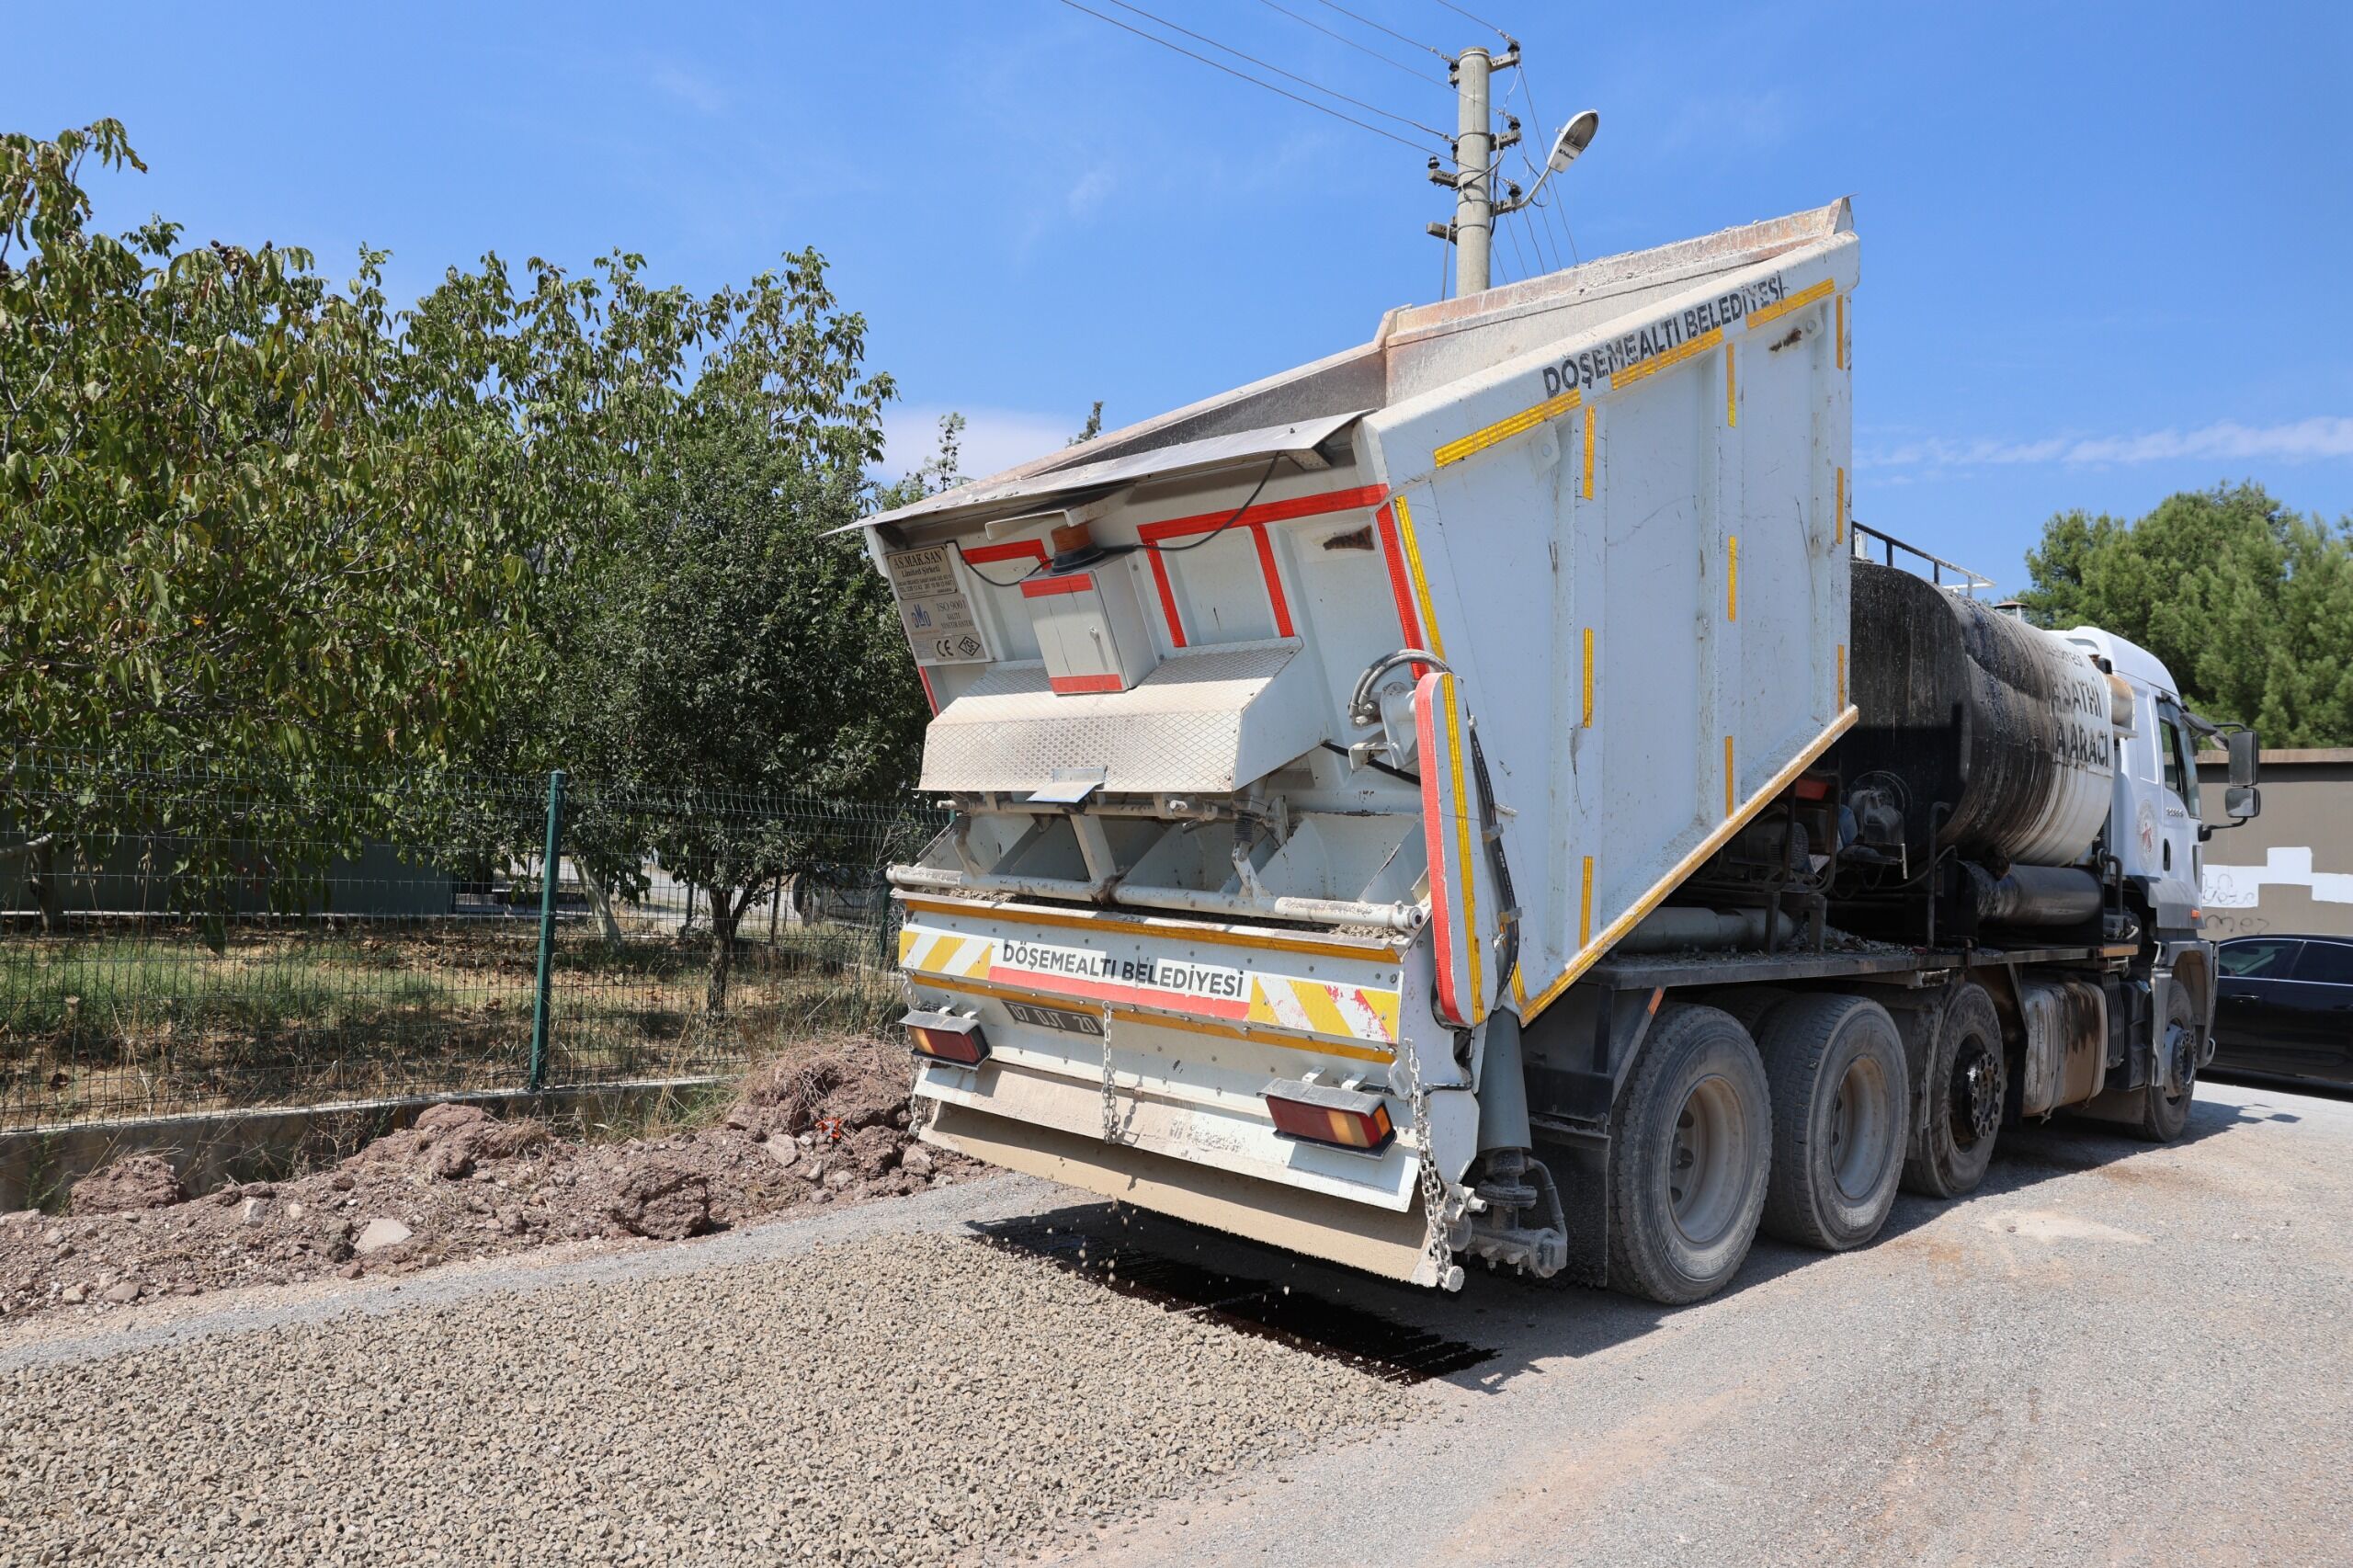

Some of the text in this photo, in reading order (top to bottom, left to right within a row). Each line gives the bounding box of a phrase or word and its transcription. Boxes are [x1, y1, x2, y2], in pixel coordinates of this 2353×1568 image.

[1684, 270, 1784, 338] BELEDİYESİ
[937, 599, 967, 612] ISO 9001
[1003, 940, 1245, 997] DÖŞEMEALTI BELEDİYESİ
[1009, 1005, 1030, 1022] 07
[1072, 1015, 1099, 1034] 20
